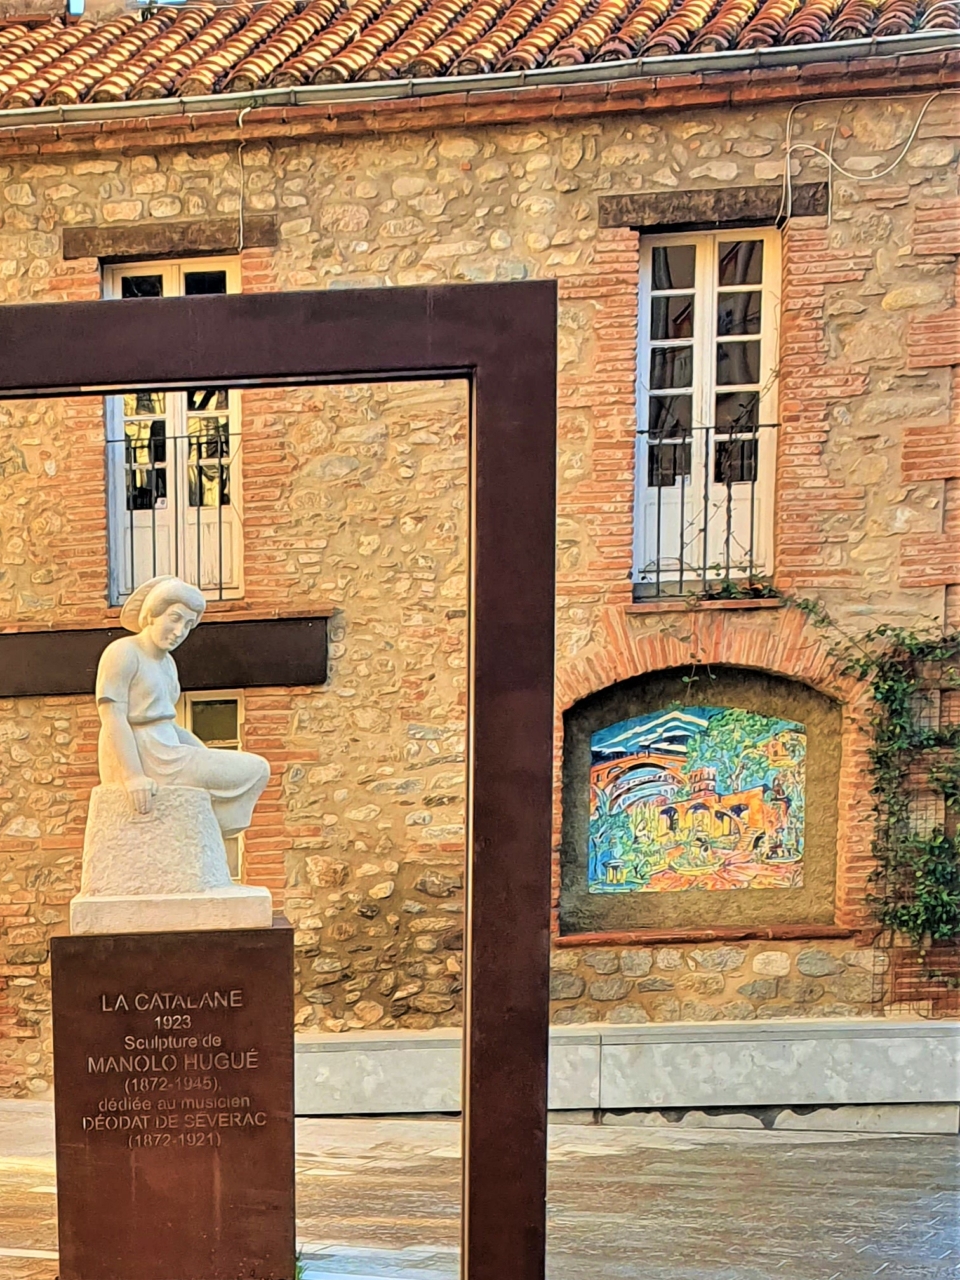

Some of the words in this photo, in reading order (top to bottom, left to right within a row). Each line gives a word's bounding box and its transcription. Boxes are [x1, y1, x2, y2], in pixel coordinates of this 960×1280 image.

[101, 994, 129, 1012] LA
[135, 990, 243, 1011] CATALANE
[154, 1014, 192, 1030] 1923
[124, 1034, 198, 1051] Sculpture
[202, 1034, 222, 1048] de
[87, 1054, 178, 1073] MANOLO
[183, 1049, 259, 1070] HUGUÉ
[98, 1097, 152, 1112] dédiée
[157, 1098, 176, 1110] au
[181, 1095, 250, 1110] musicien
[82, 1113, 151, 1131] DÉODAT
[155, 1115, 178, 1129] DE
[128, 1132, 222, 1149] (1872-1921)
